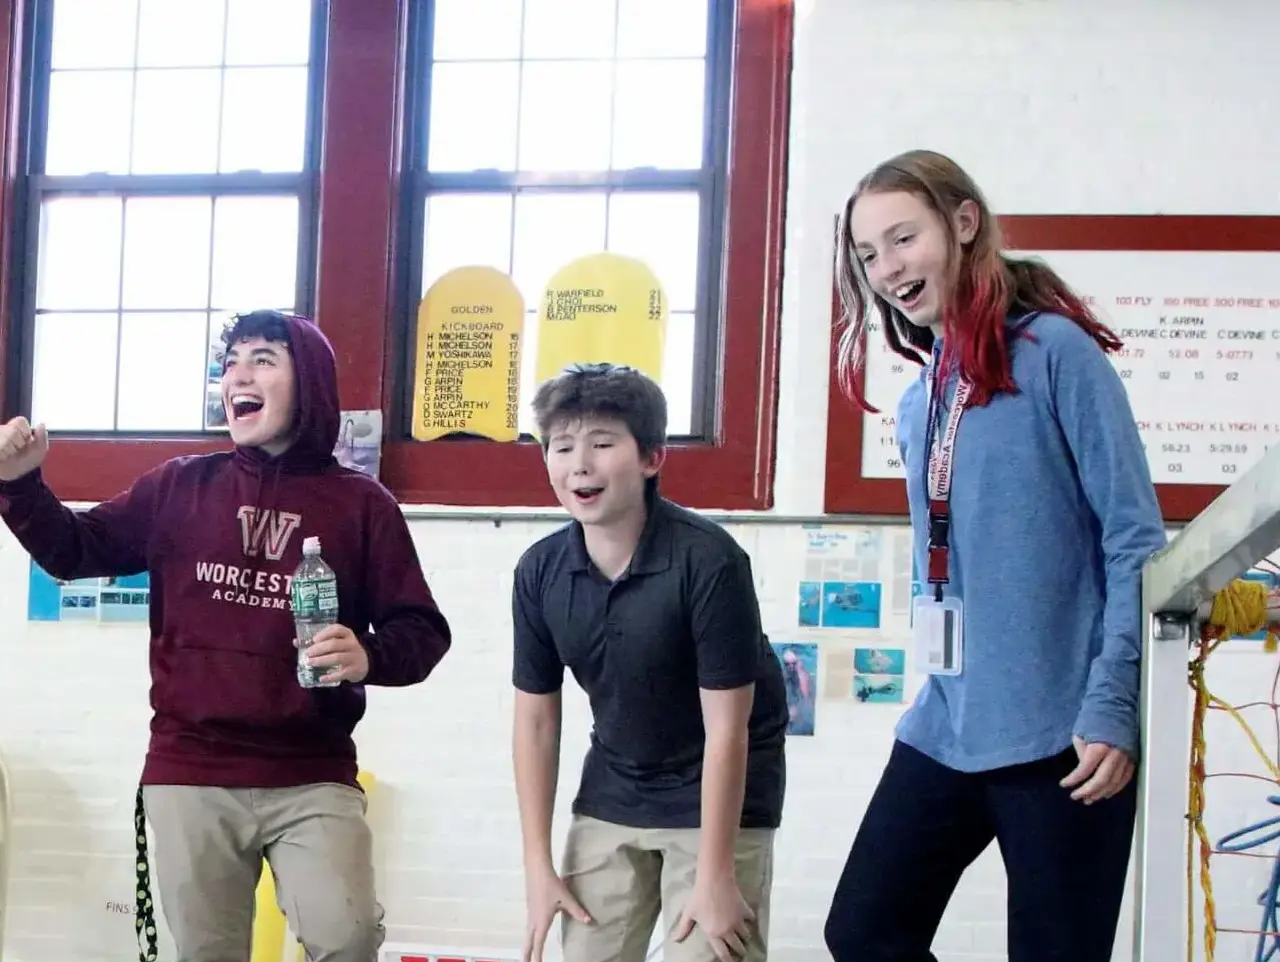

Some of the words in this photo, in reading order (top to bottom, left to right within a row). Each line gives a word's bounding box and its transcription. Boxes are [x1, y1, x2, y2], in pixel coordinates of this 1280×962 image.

[1183, 298, 1209, 307] FREE
[1237, 298, 1263, 307] FREE
[451, 305, 493, 314] GOLDEN
[441, 322, 504, 331] KICKBOARD
[438, 332, 494, 341] MICHELSON
[1169, 329, 1208, 339] DEVINE
[1228, 330, 1266, 340] DEVINE
[438, 341, 494, 350] MICHELSON
[438, 350, 492, 359] YOSHIKAWA
[437, 360, 493, 369] MICHELSON
[891, 364, 904, 374] 96
[435, 369, 465, 377] PRICE
[434, 377, 463, 386] ARPIN
[434, 385, 463, 393] PRICE
[433, 393, 463, 401] ARPIN
[433, 410, 473, 419] SWARTZ
[433, 419, 466, 428] HILLIS
[887, 458, 901, 469] 96
[237, 505, 302, 561] W
[195, 561, 295, 596] WORCEST
